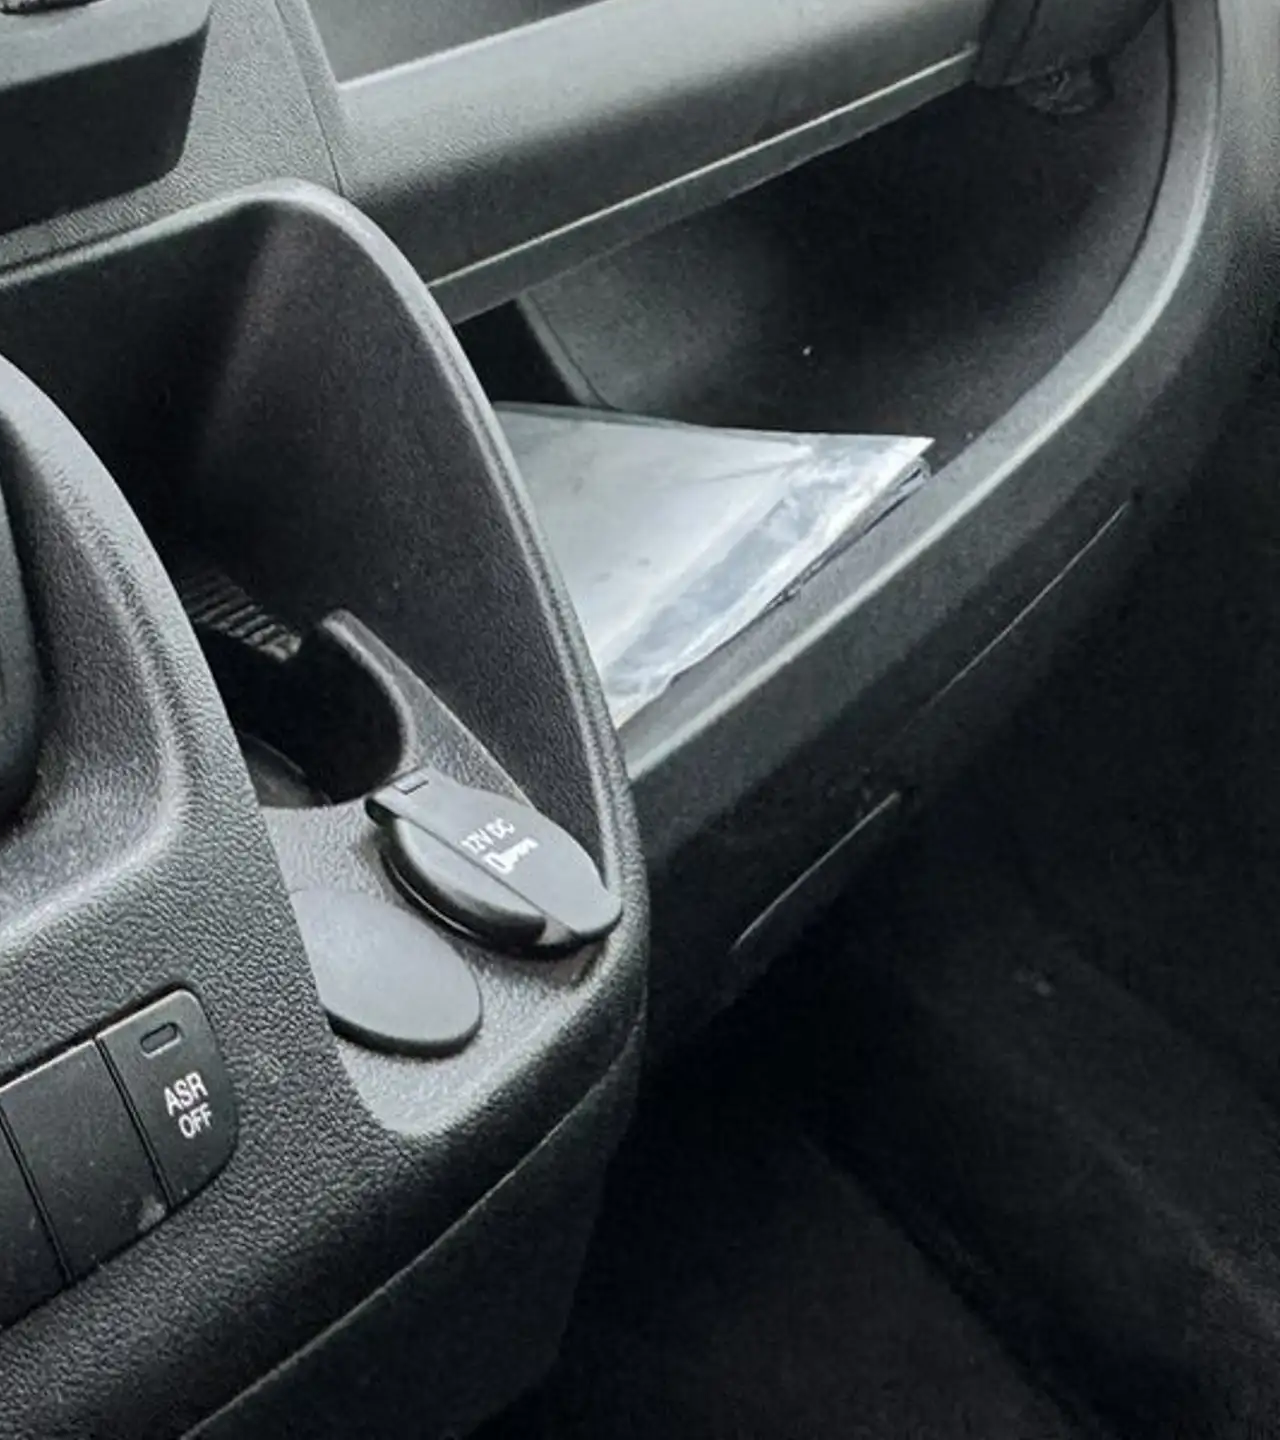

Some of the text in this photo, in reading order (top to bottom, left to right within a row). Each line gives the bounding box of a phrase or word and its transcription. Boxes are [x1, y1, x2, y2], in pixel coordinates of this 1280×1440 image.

[461, 817, 516, 856] 12V DC
[164, 1071, 209, 1117] ASR
[178, 1102, 213, 1139] OFF
